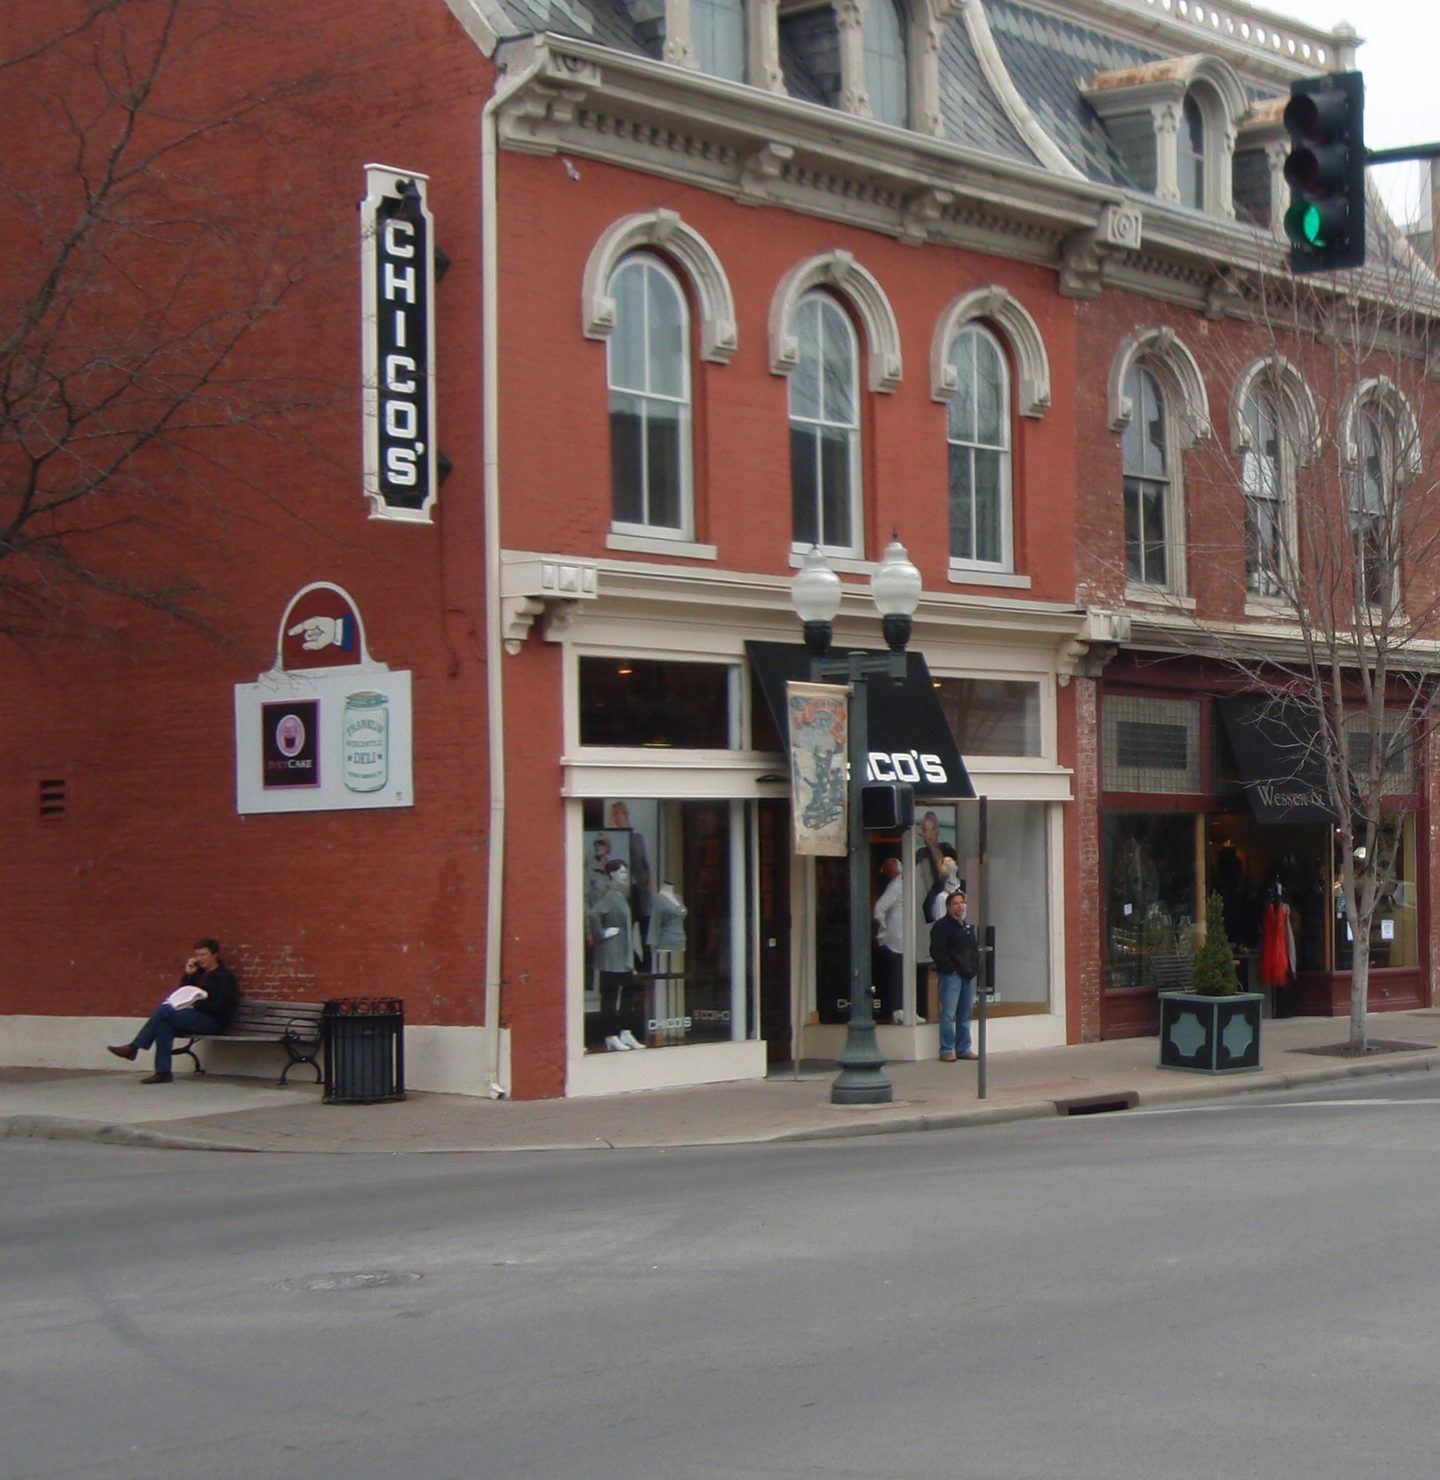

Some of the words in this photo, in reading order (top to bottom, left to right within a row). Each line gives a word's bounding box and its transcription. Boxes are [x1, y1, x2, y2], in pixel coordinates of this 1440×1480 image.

[384, 218, 425, 486] CHICO'S
[347, 719, 384, 737] FRANKLIN
[354, 751, 376, 765] DELI
